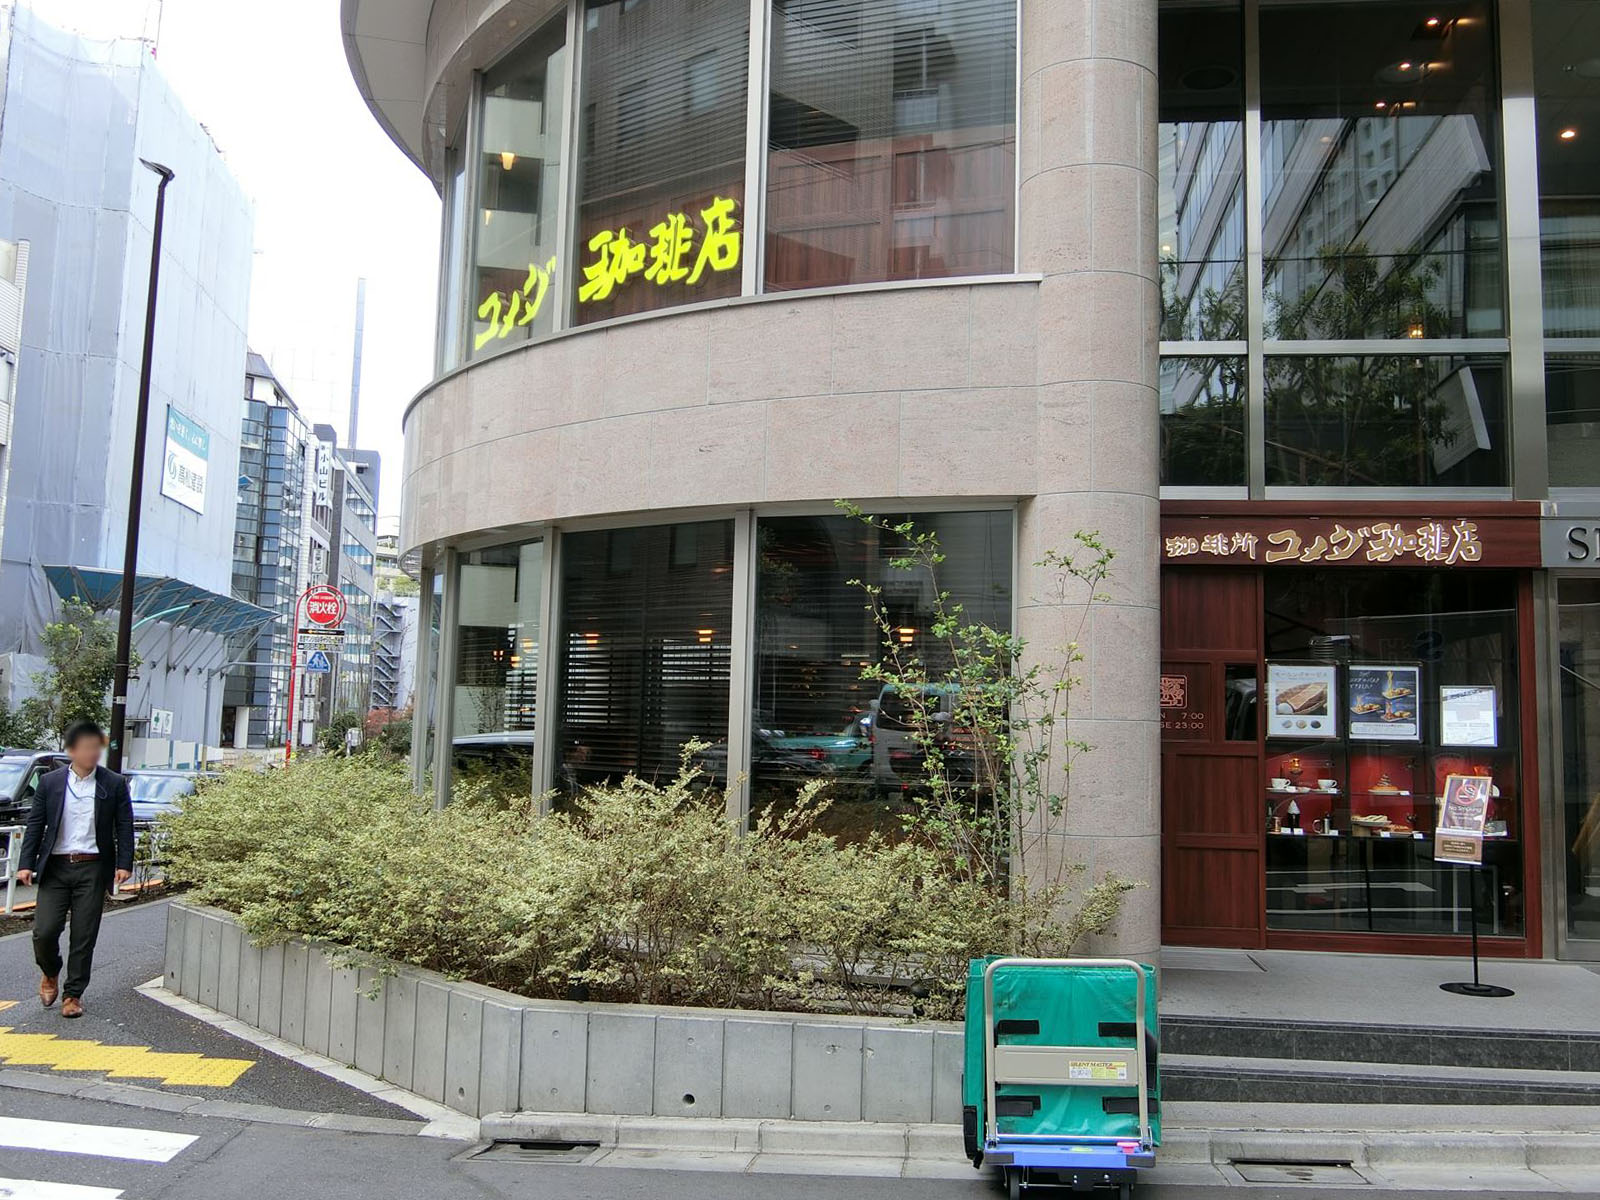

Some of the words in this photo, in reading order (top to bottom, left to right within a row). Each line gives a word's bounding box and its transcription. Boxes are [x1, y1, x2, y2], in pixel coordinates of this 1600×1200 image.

[317, 454, 330, 502] 小山ビル
[1165, 532, 1259, 560] 珈琲所
[1265, 520, 1483, 565] コメダ珈琲店
[309, 602, 338, 615] 消火栓
